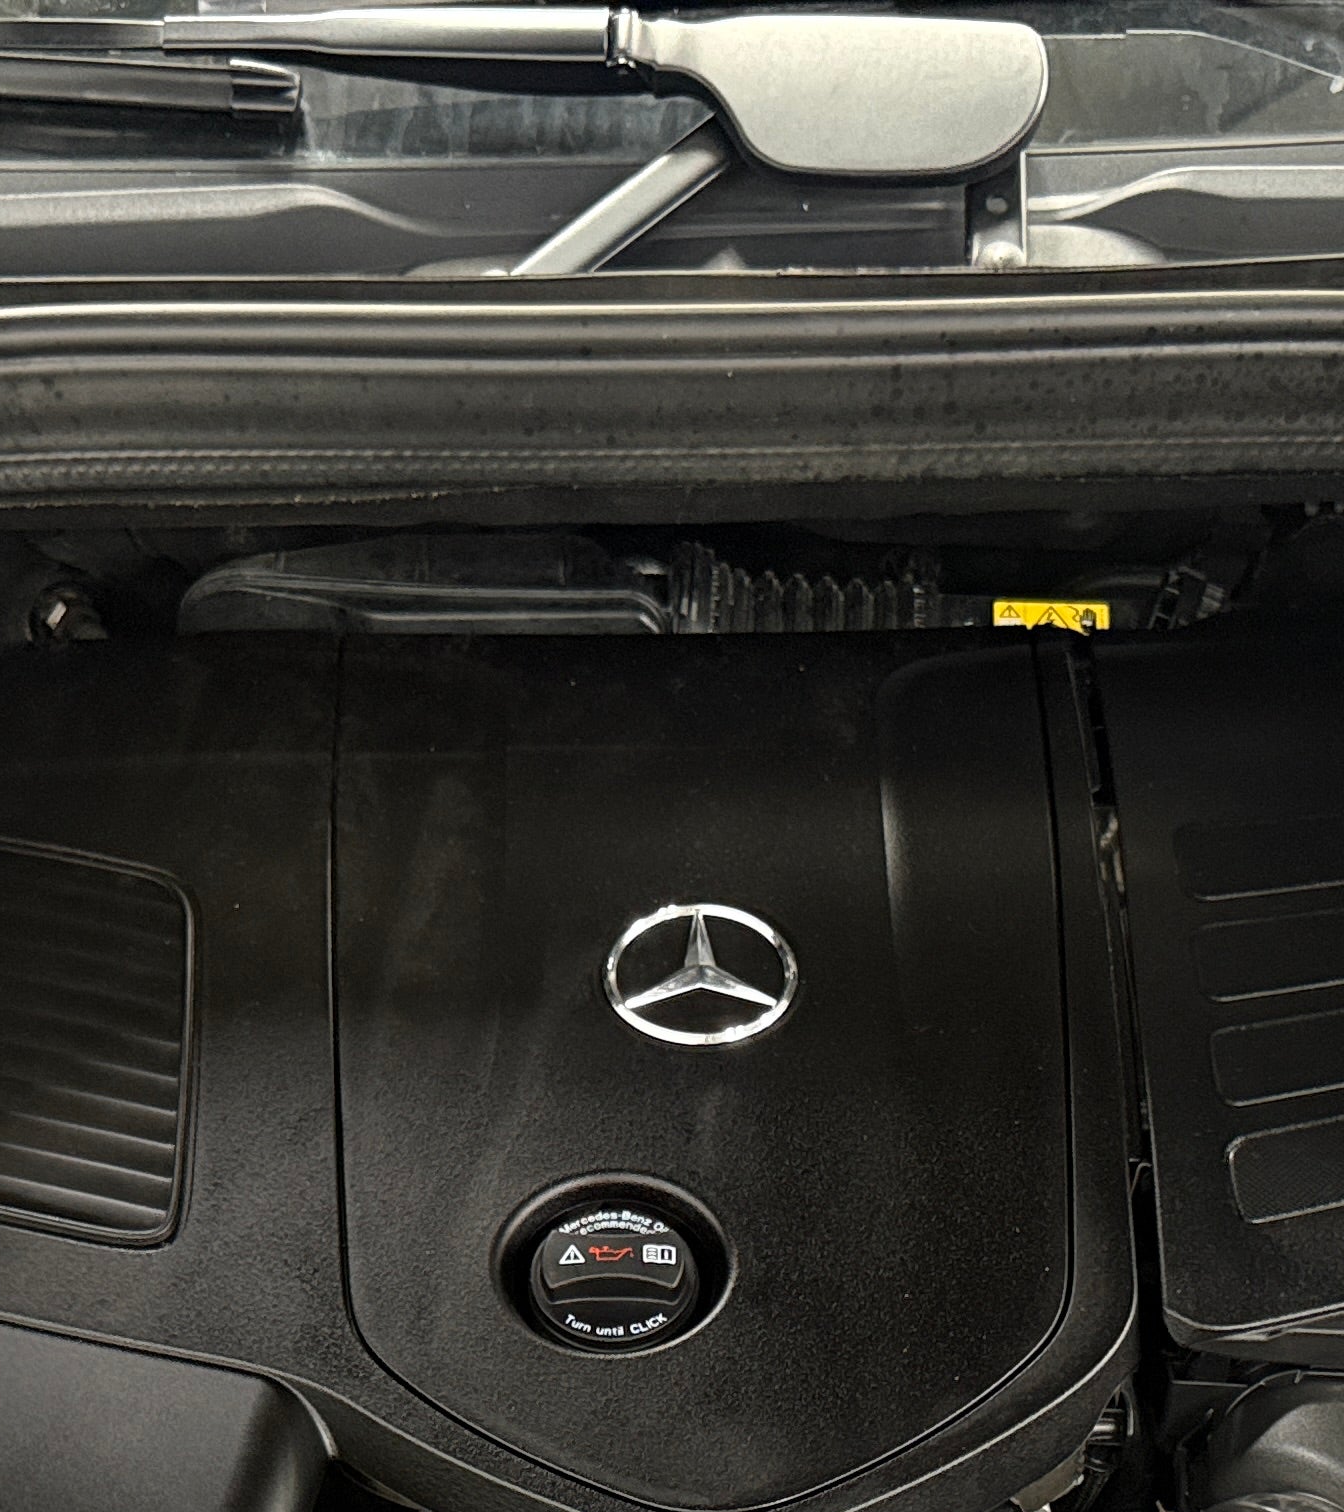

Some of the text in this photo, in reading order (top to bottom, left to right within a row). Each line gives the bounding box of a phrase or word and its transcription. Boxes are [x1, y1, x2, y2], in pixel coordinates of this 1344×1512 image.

[558, 1210, 653, 1234] Mercedes-Benz
[564, 1312, 668, 1337] Turn until CLICK
